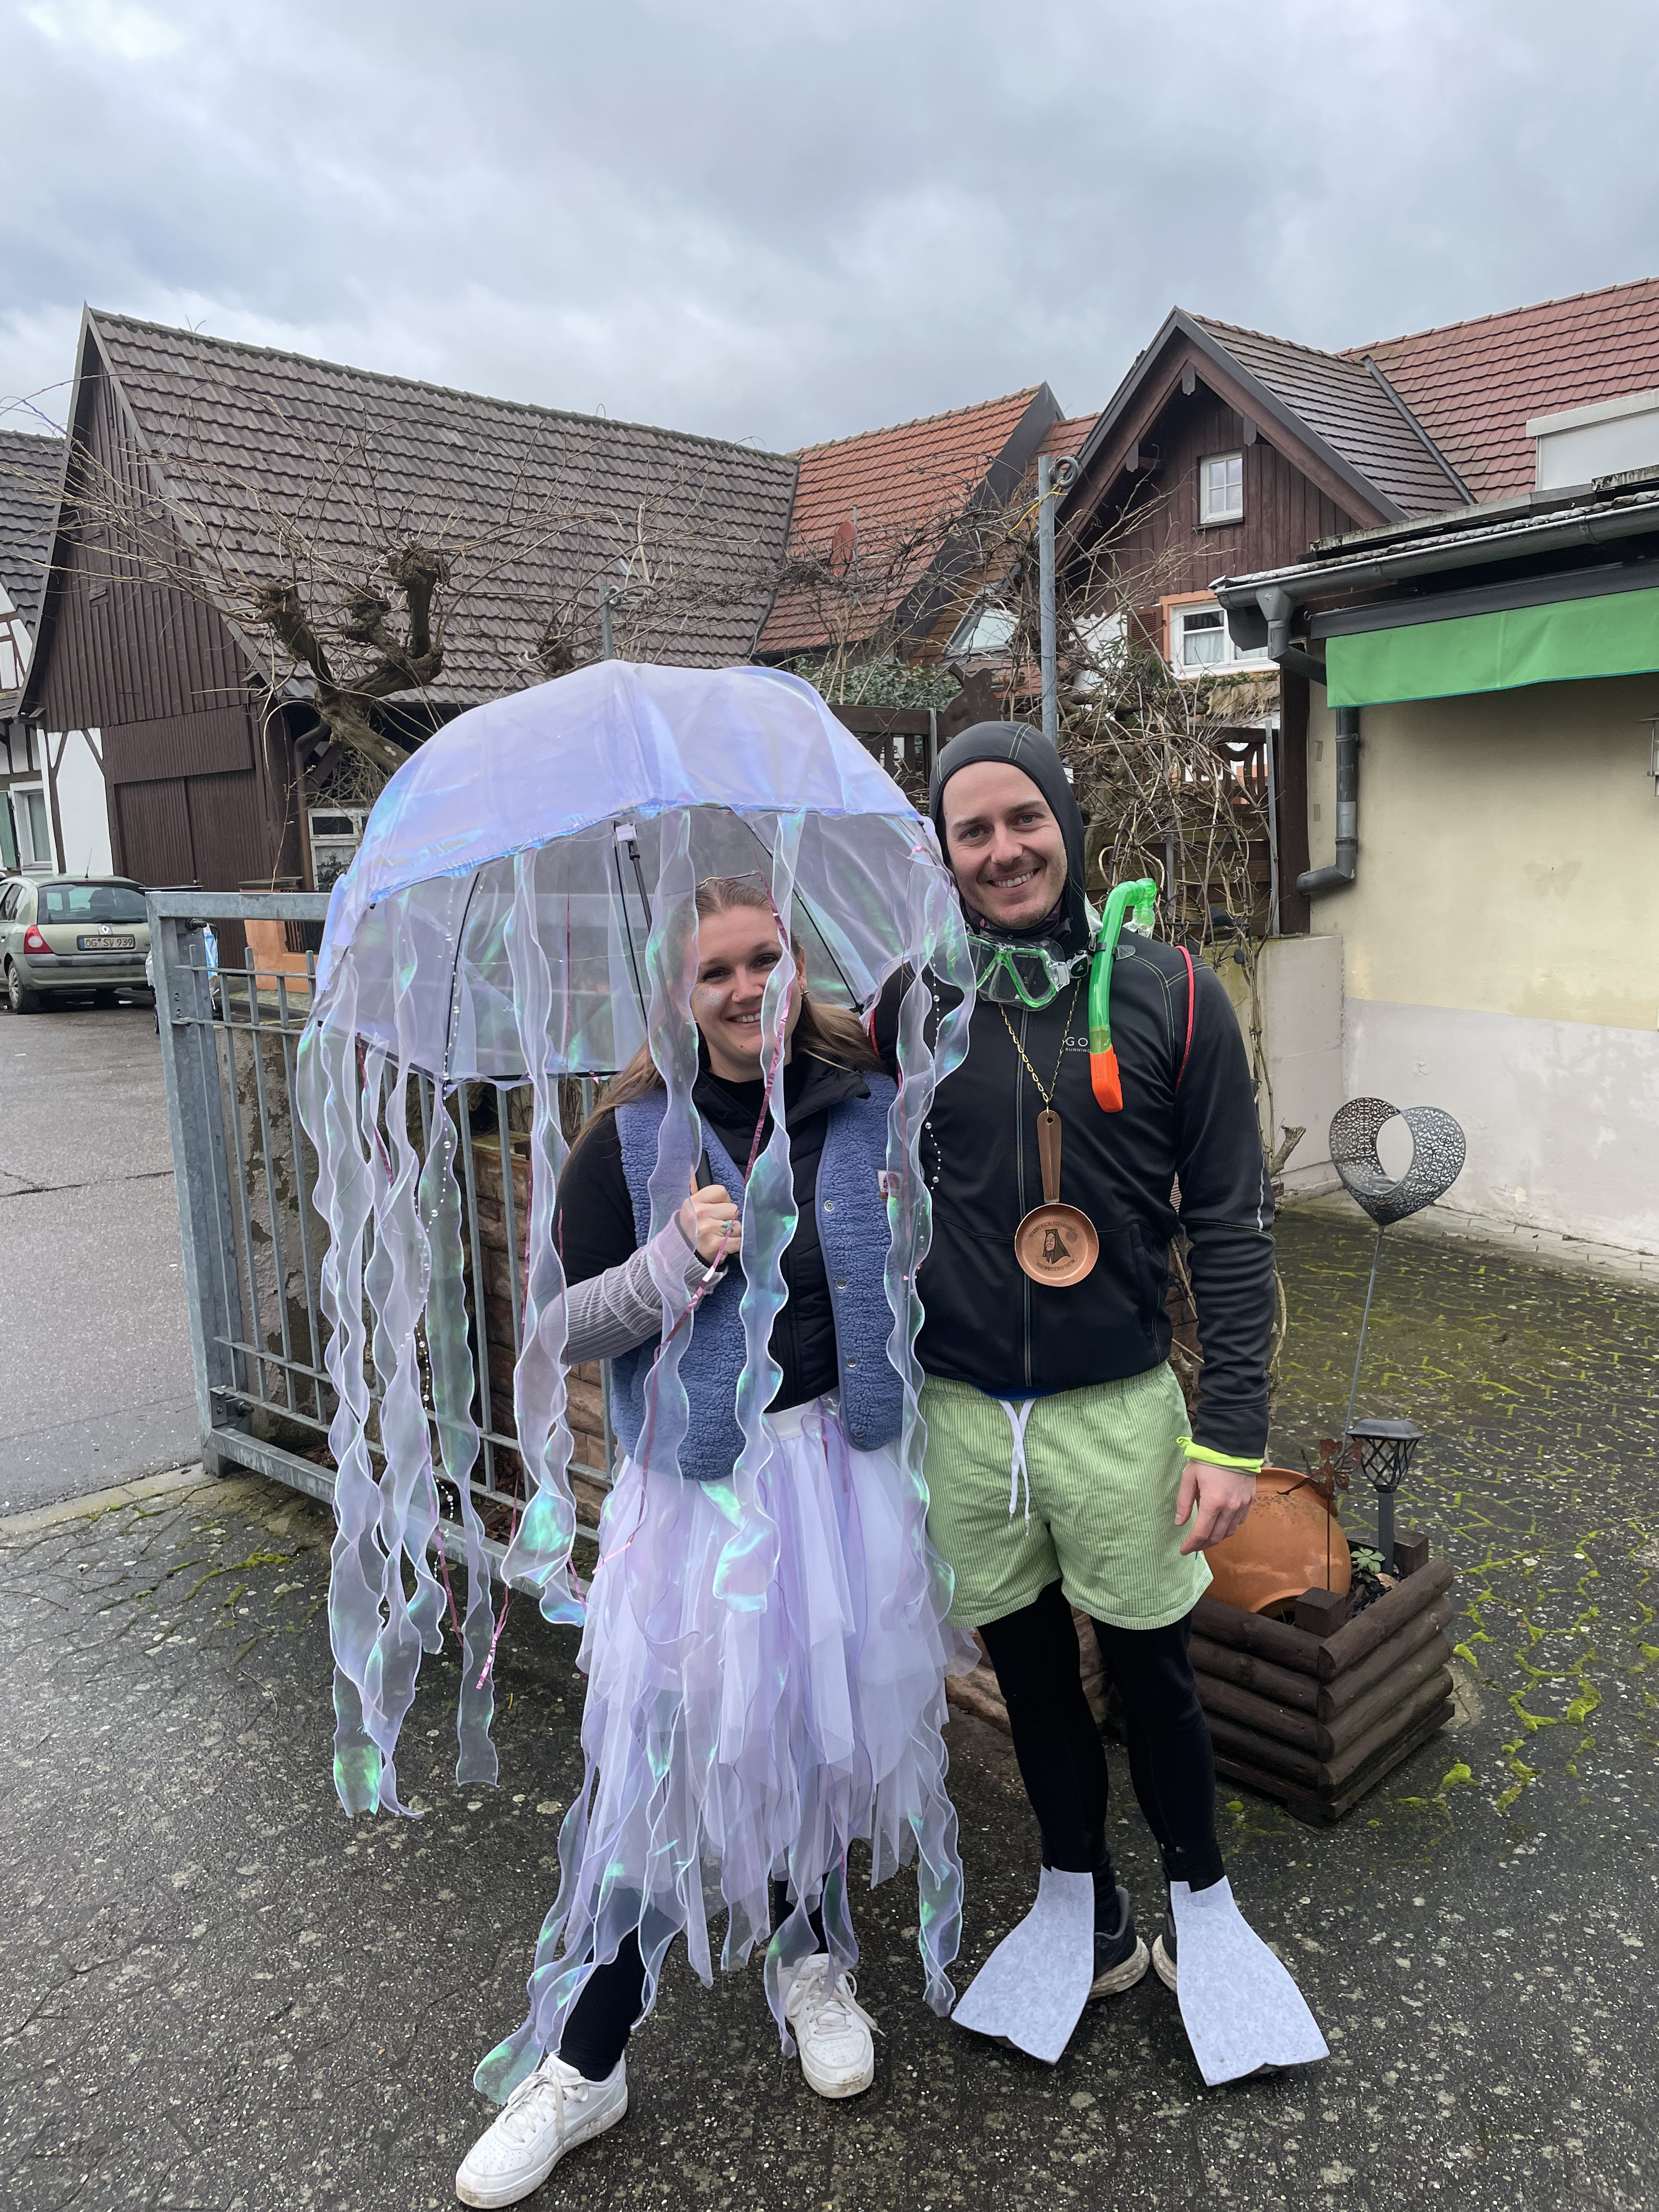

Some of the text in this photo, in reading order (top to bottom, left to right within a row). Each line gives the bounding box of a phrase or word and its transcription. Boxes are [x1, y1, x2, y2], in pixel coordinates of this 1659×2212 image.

[86, 938, 132, 947] OG SV 939
